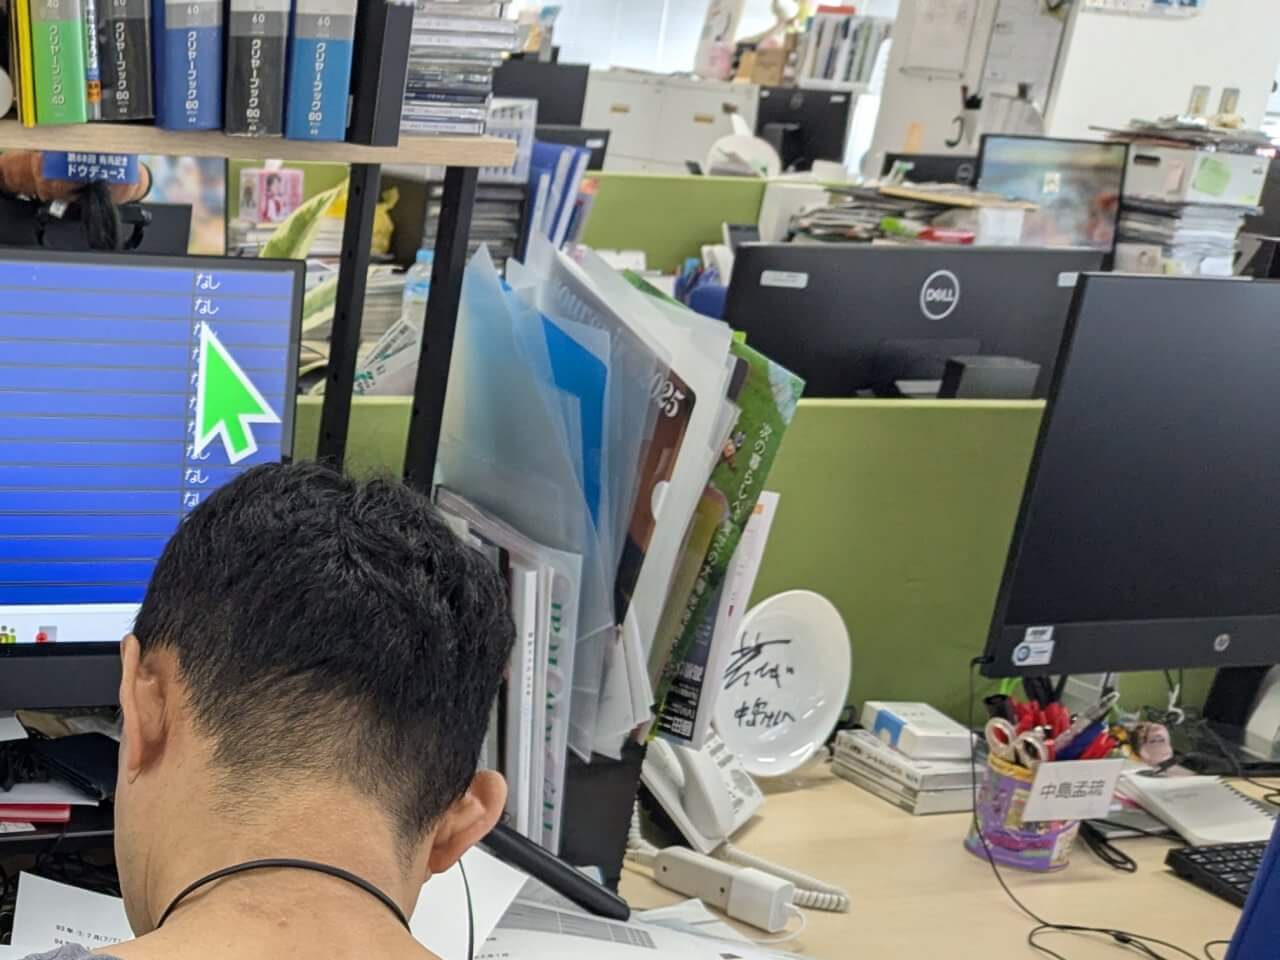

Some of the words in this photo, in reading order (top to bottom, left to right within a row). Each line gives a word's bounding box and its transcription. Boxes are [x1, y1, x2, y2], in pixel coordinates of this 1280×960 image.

[67, 163, 127, 180] ドウデュース
[196, 273, 221, 290] なし
[926, 287, 954, 302] DELL
[194, 298, 219, 315] なし
[184, 469, 209, 484] なし
